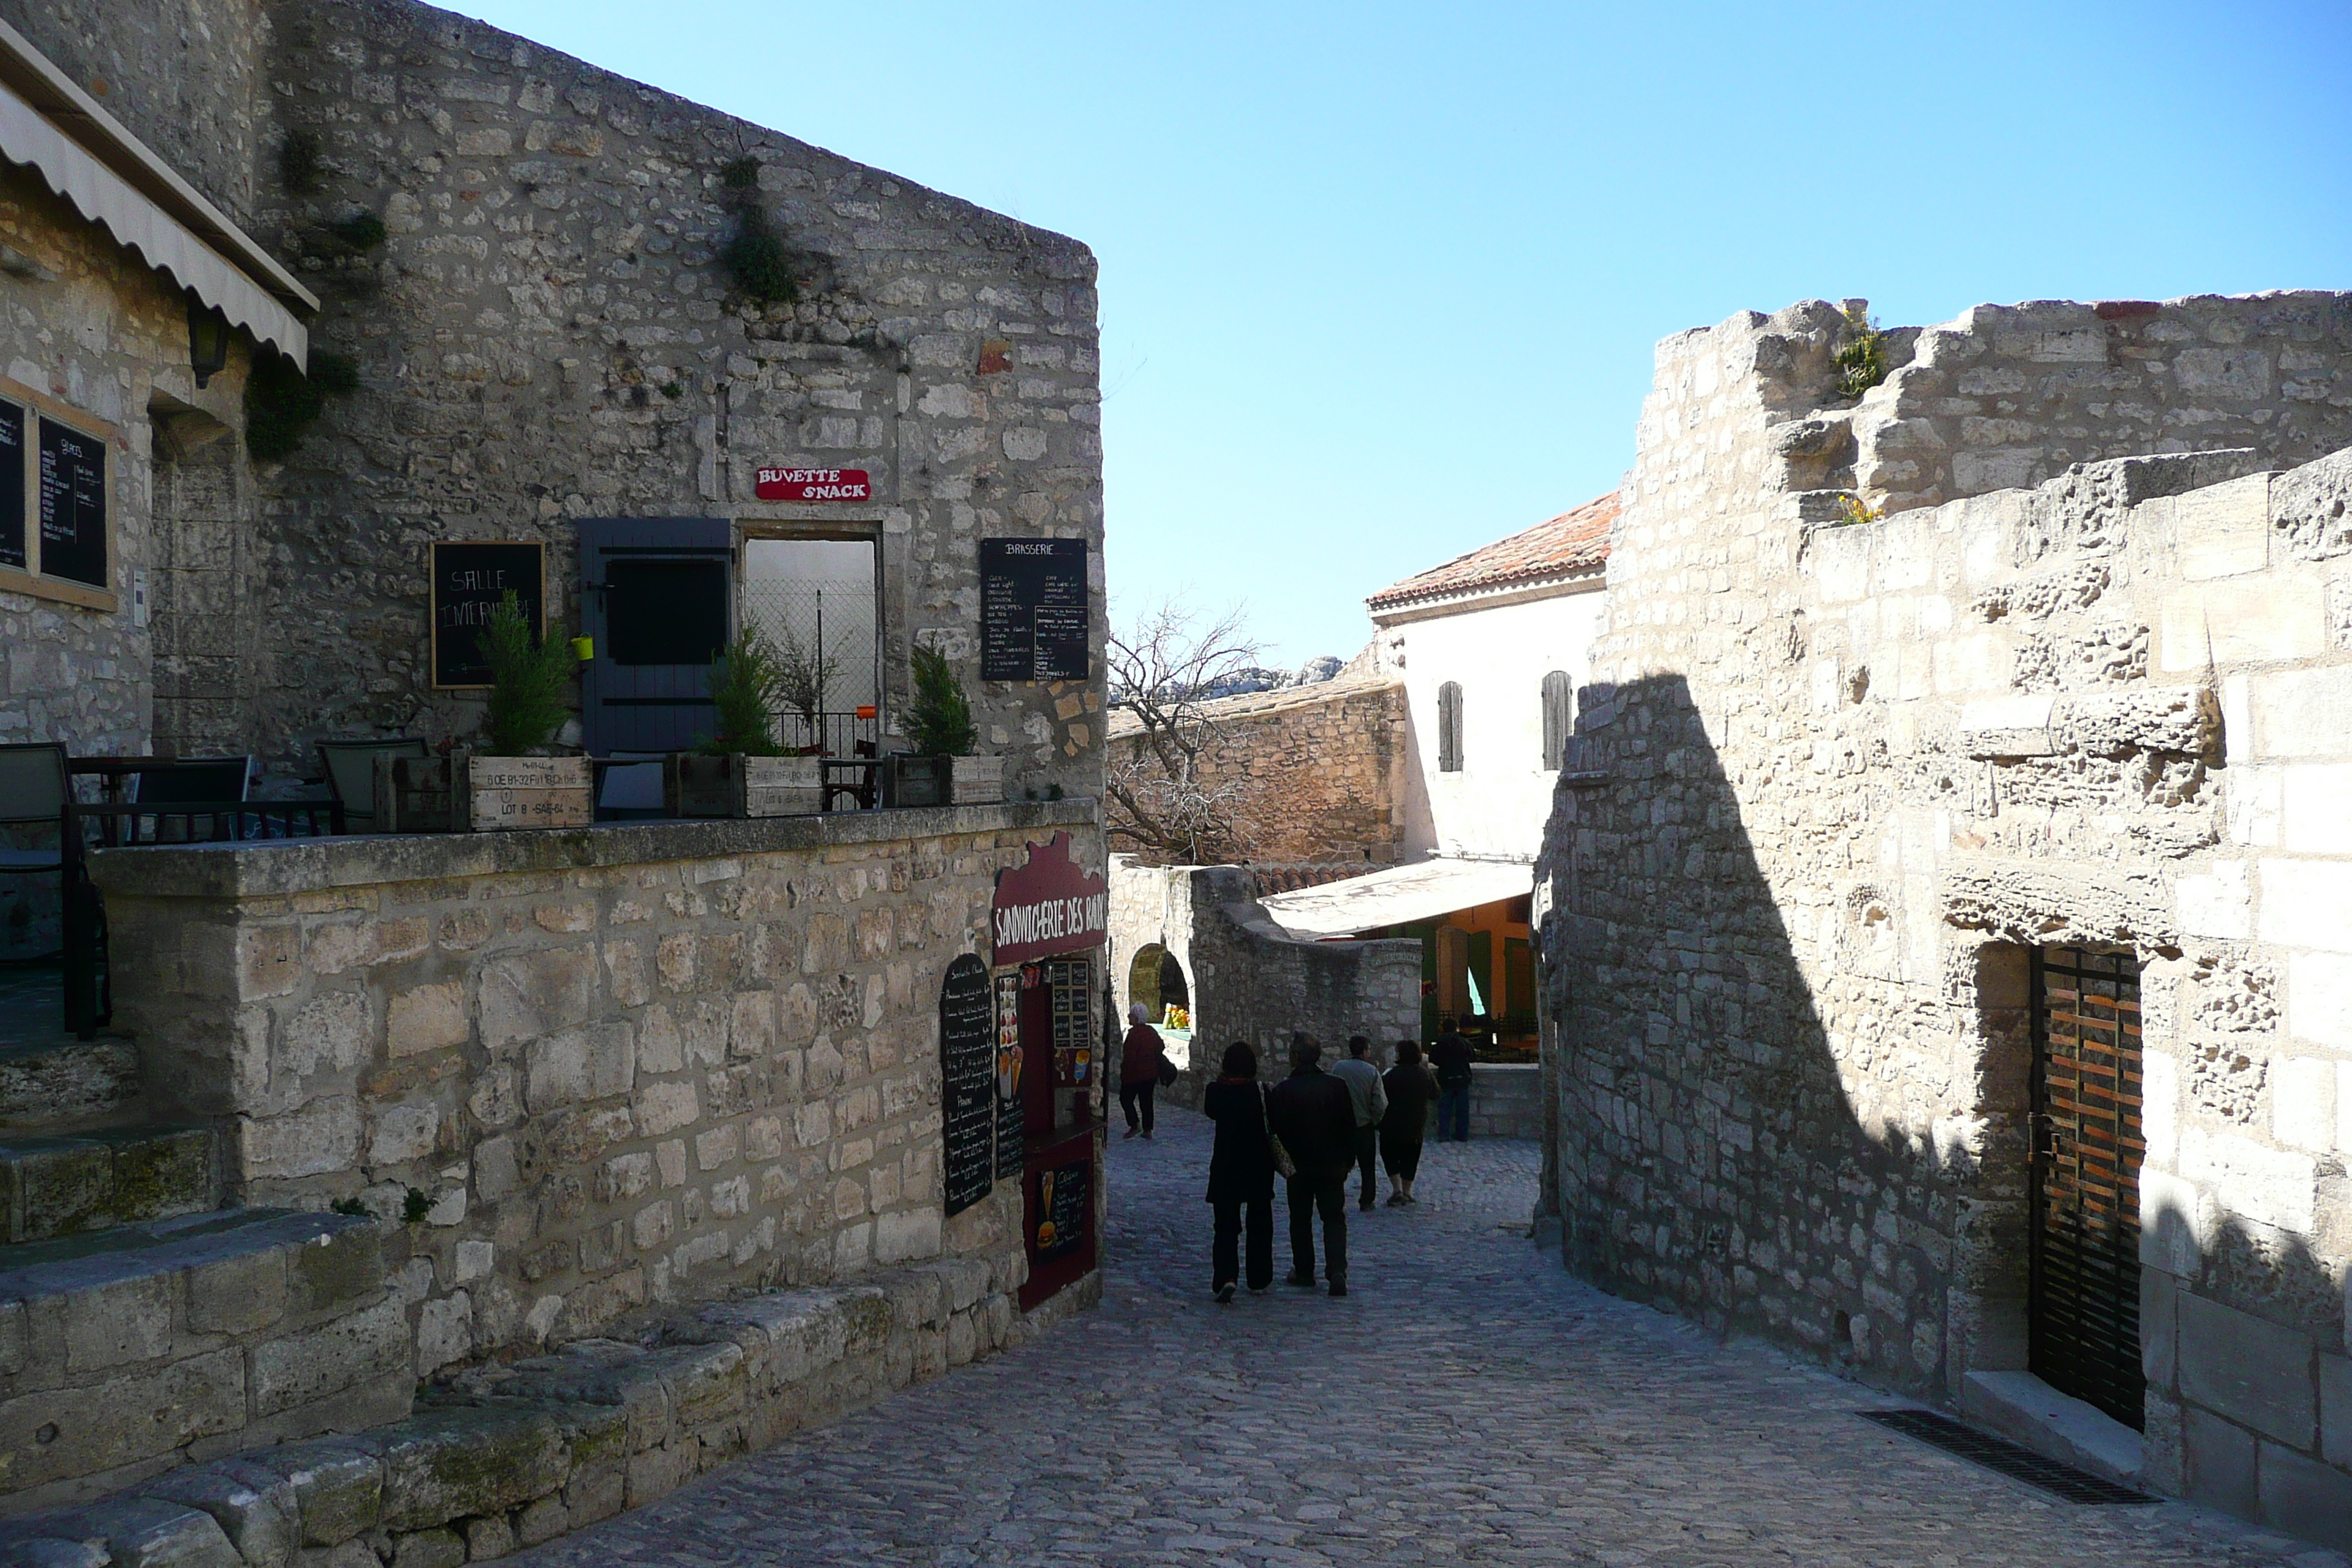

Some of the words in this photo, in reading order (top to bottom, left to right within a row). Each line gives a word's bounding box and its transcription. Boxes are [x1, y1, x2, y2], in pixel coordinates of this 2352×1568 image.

[758, 469, 840, 484] BUVETTE
[802, 483, 866, 500] SNACK
[1005, 543, 1055, 556] BRASSERIE
[449, 569, 506, 592] SALLE
[440, 599, 535, 628] INTERIRE
[501, 804, 517, 815] LOT
[996, 898, 1065, 949] SANDWICHERIE
[1067, 897, 1084, 935] DES
[1086, 892, 1104, 932] BAUX
